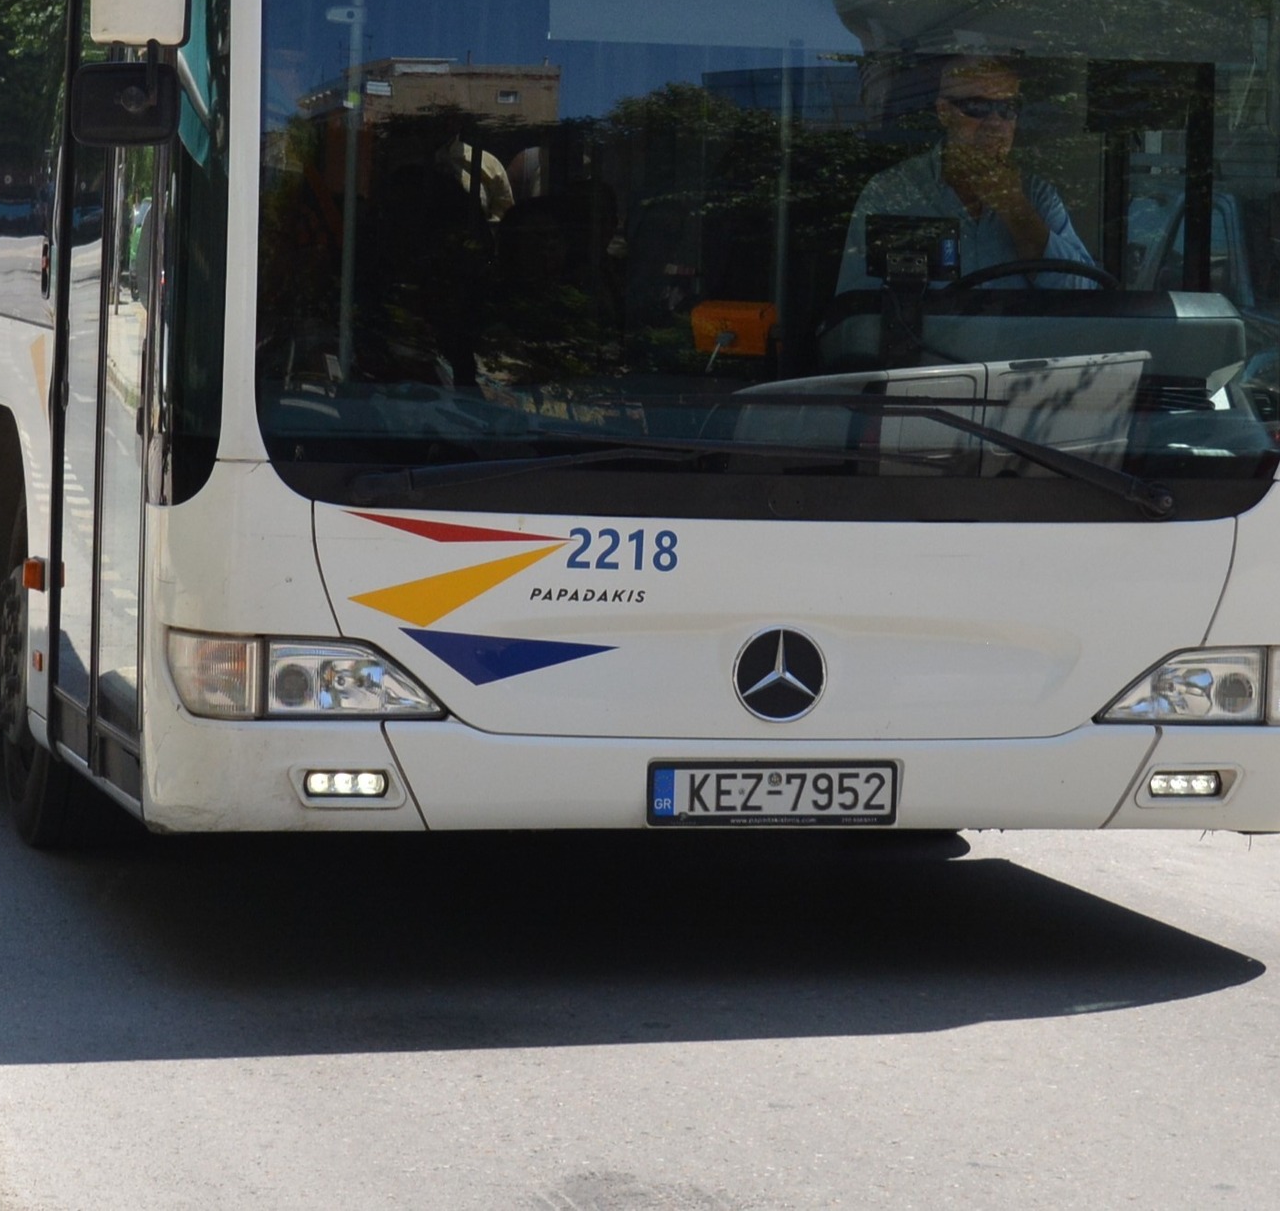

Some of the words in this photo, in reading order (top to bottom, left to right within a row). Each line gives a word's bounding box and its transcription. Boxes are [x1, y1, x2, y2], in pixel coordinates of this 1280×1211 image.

[566, 527, 678, 572] 2218
[529, 587, 646, 603] PAPADAKIS
[654, 798, 672, 810] GR
[688, 772, 886, 812] KEZ-7952
